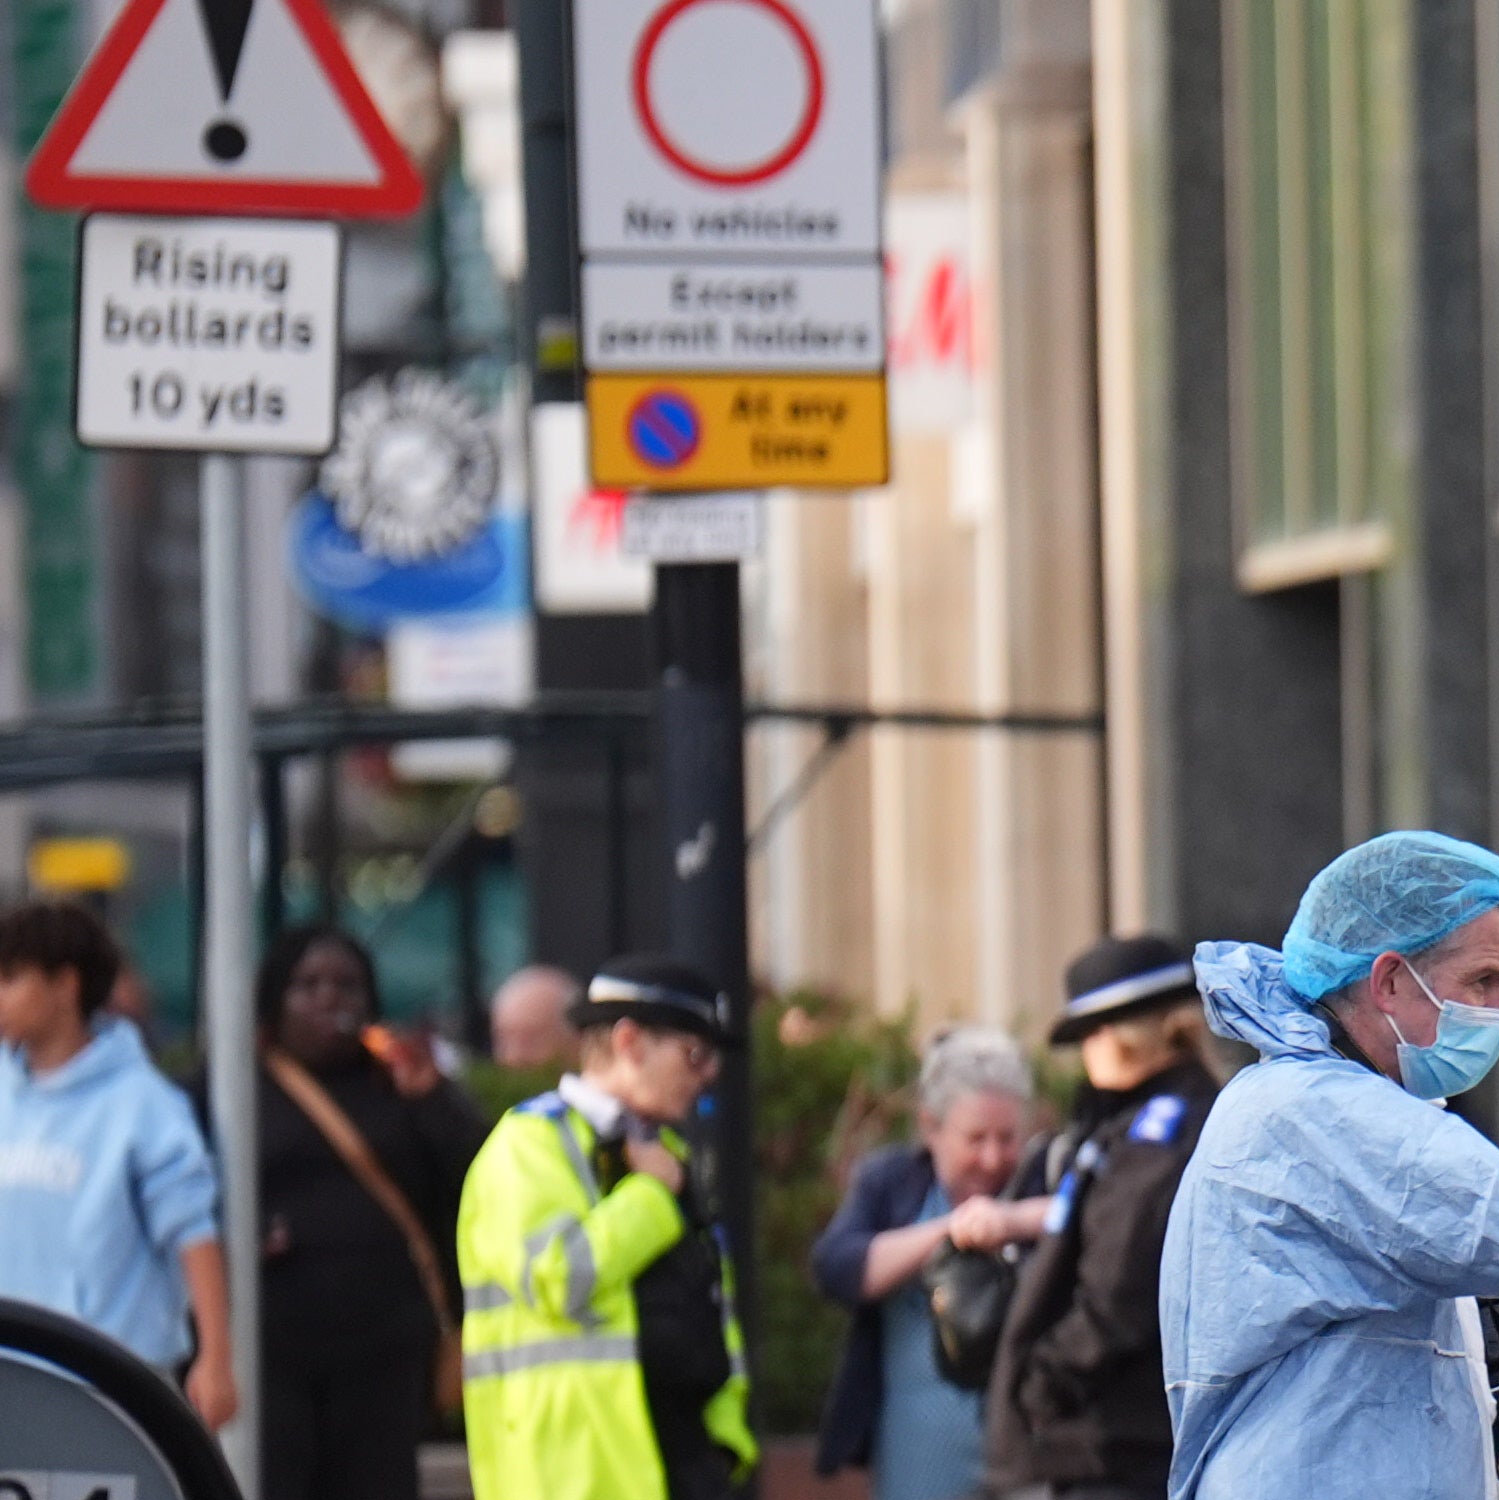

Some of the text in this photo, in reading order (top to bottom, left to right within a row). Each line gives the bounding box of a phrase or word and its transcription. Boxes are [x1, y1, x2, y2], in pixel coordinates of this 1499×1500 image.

[624, 202, 838, 236] No vehicles
[133, 238, 288, 294] Rising
[671, 273, 797, 313] Except
[104, 298, 311, 348] bollards
[600, 320, 868, 352] permit holders
[131, 371, 284, 427] 10 yds
[731, 390, 847, 428] At any
[751, 436, 829, 465] time
